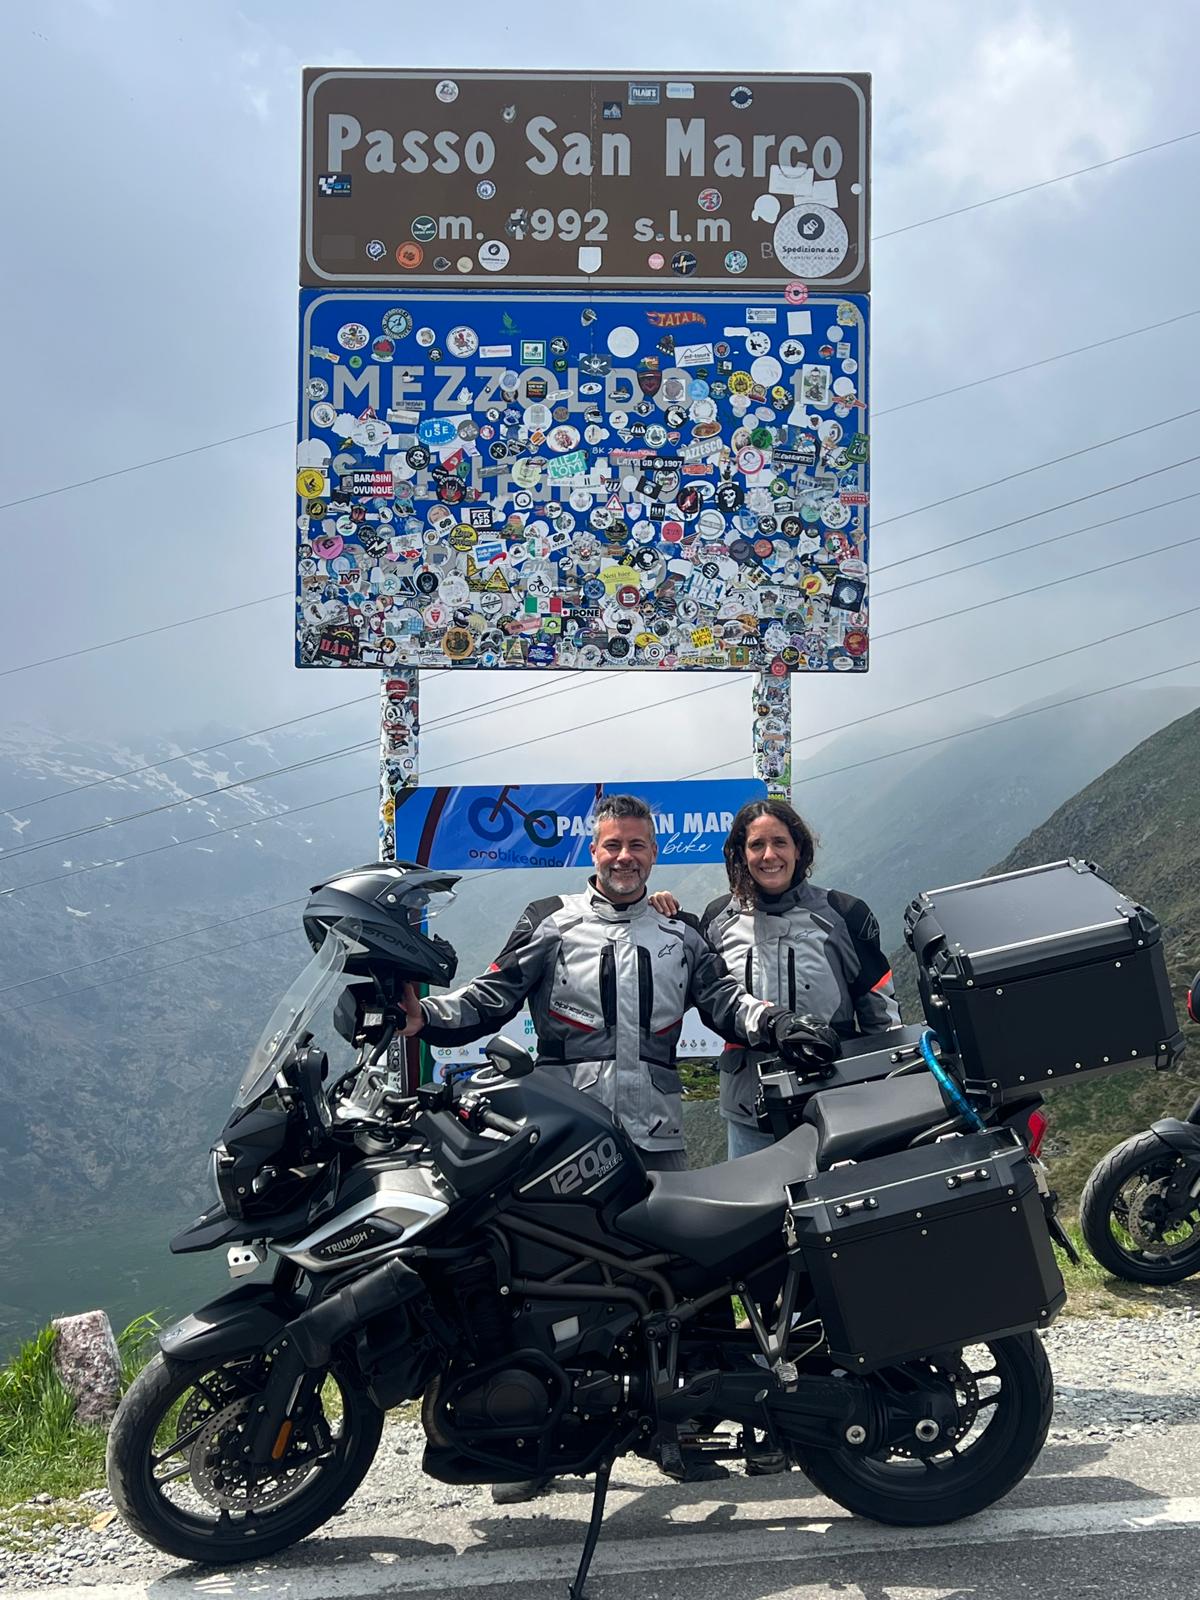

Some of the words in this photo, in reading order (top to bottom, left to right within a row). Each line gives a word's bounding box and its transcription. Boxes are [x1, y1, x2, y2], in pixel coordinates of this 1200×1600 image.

[328, 113, 496, 174] Passo
[525, 115, 631, 176] San
[666, 118, 842, 179] Marco
[439, 215, 484, 241] m.
[782, 246, 825, 255] Spedizione
[333, 364, 695, 413] MEZZOLDO
[664, 460, 682, 468] 1907
[353, 473, 392, 483] BARASINI
[353, 485, 393, 495] OVUNQUE
[472, 512, 490, 520] FCK
[569, 609, 599, 617] IPONE
[556, 816, 594, 837] PAS
[655, 813, 675, 834] AN
[683, 812, 734, 833] MAR
[662, 832, 712, 855] bike
[469, 848, 564, 867] orobikeando
[549, 1137, 617, 1195] 1200
[325, 1231, 368, 1255] TRIUMPH
